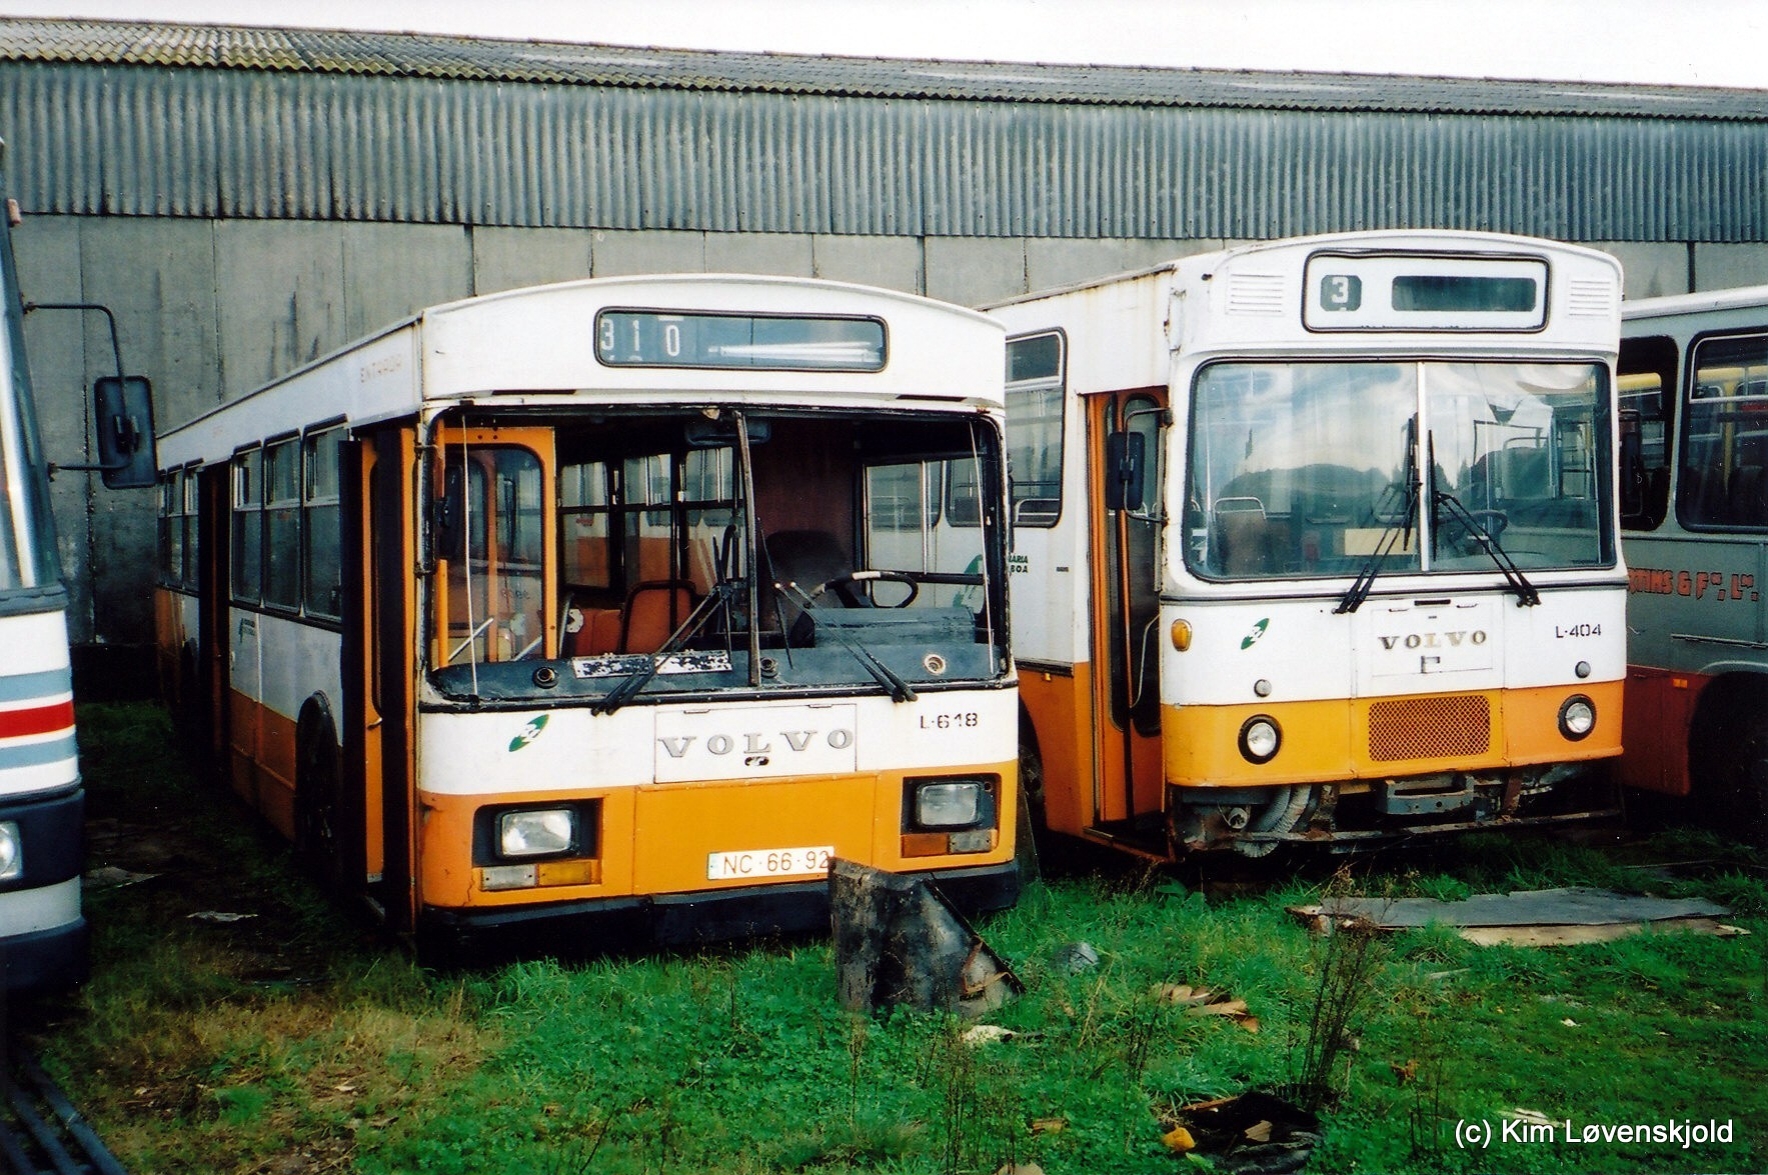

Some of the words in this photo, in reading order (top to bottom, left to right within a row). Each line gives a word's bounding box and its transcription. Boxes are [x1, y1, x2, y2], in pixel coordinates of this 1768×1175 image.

[1331, 276, 1349, 304] 3
[1378, 630, 1487, 650] VOLVO
[657, 729, 853, 758] VOLVO
